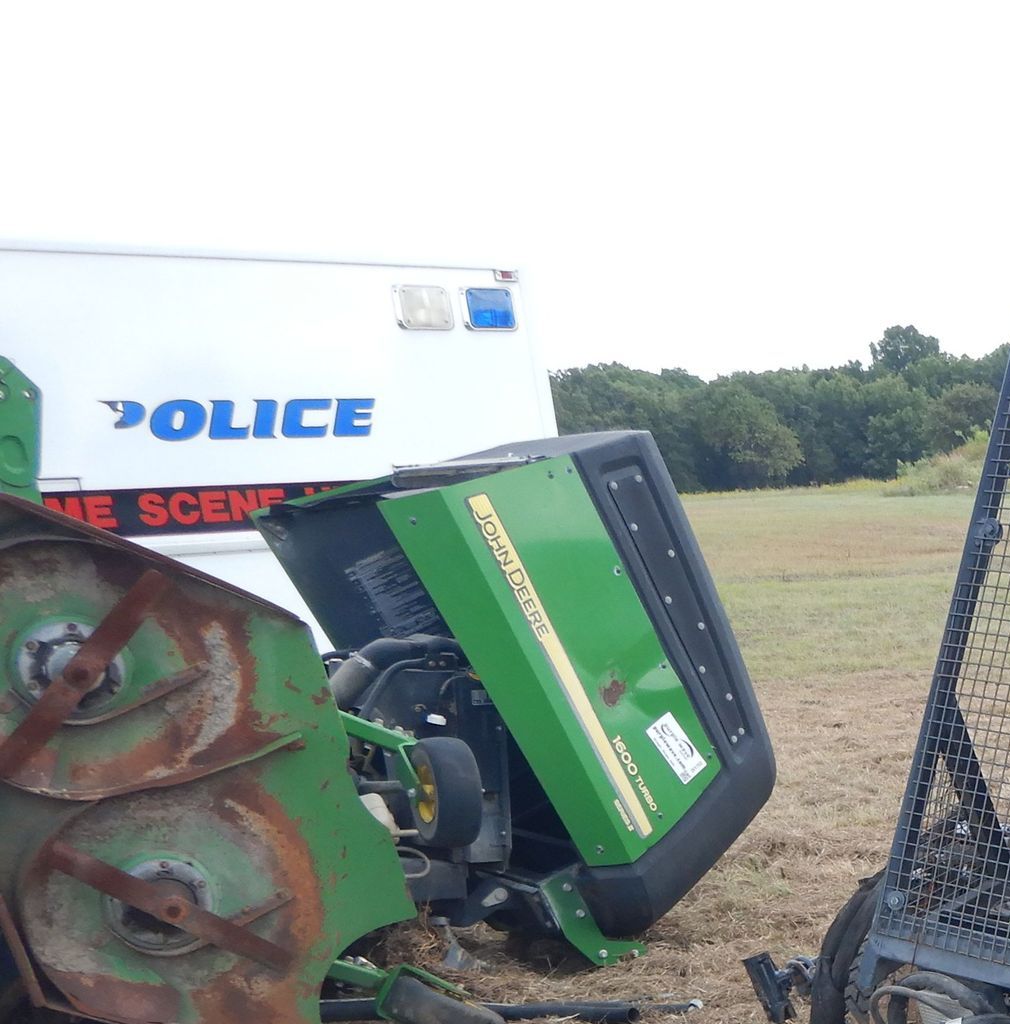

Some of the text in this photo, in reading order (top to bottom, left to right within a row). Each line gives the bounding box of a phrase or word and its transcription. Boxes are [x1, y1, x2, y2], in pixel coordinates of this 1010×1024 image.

[98, 398, 376, 441] POLICE
[475, 510, 549, 638] JOHN DEERE
[612, 735, 657, 811] 1600 TURBO
